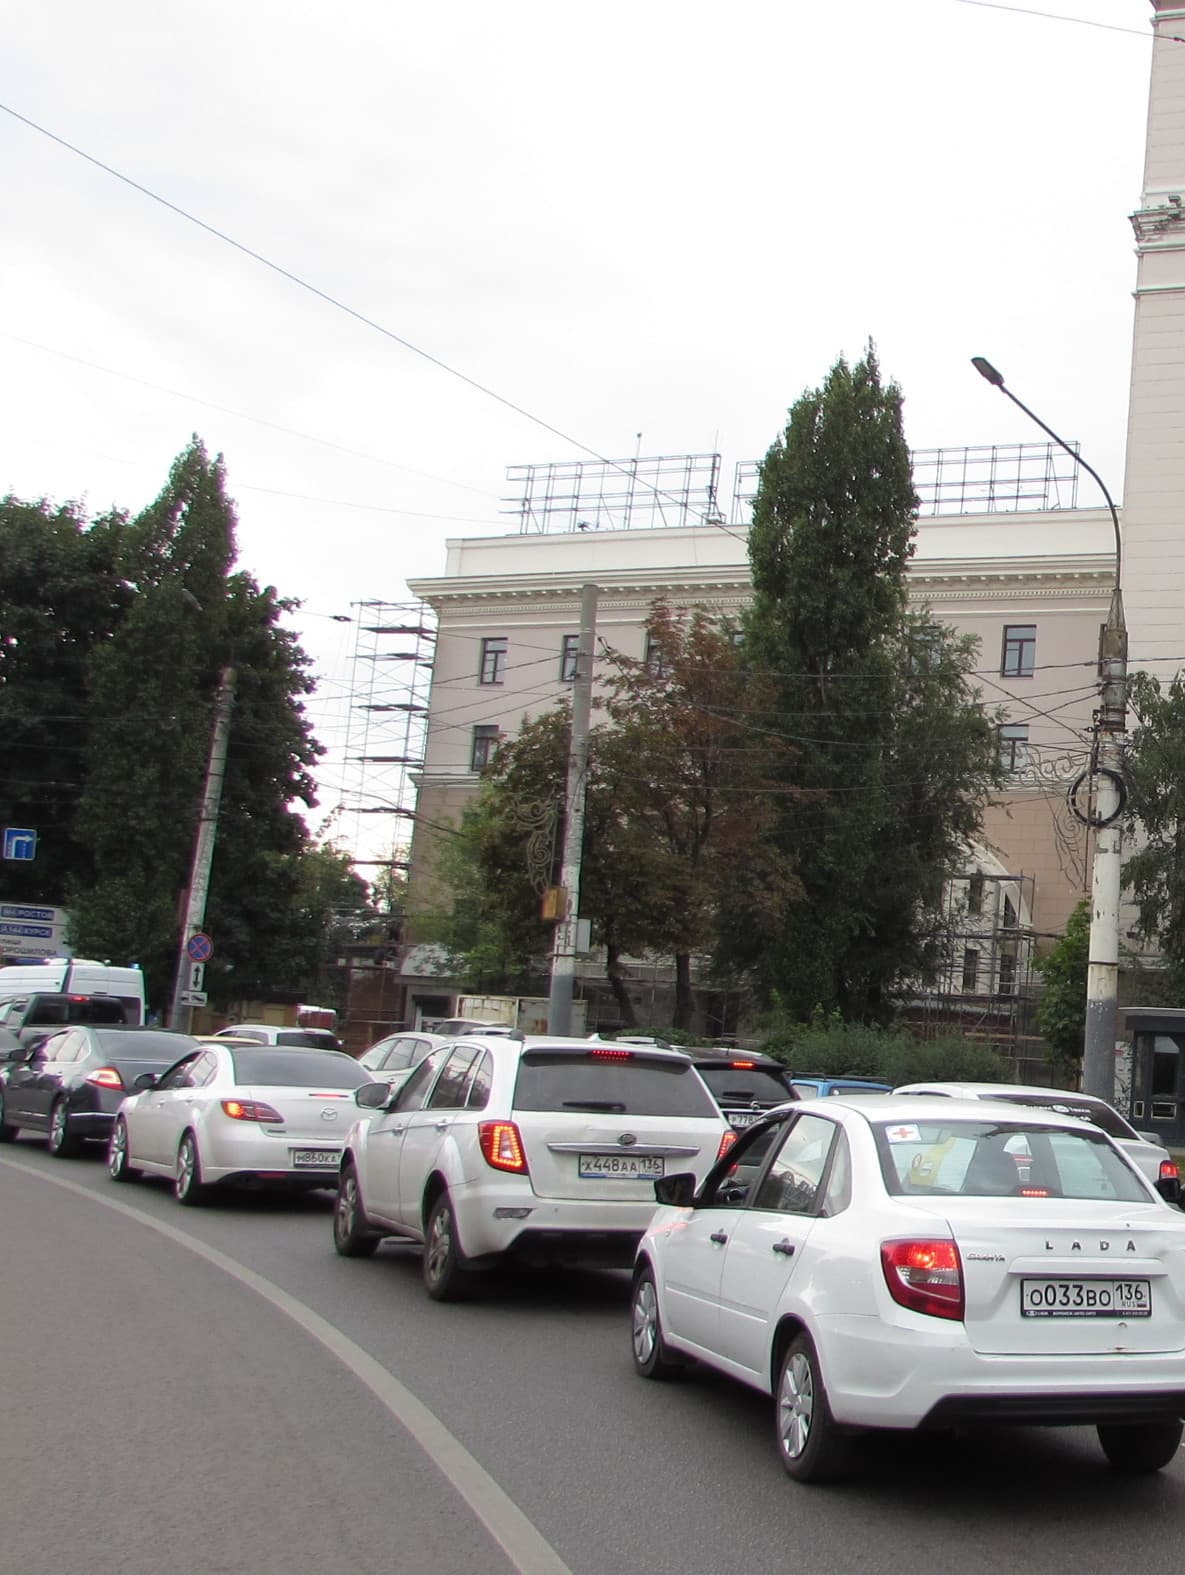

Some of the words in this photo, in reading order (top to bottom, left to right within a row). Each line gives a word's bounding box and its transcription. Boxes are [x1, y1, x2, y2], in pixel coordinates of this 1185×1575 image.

[1045, 1240, 1136, 1251] LADA
[1029, 1284, 1111, 1307] О033ВО
[1115, 1283, 1144, 1301] 136
